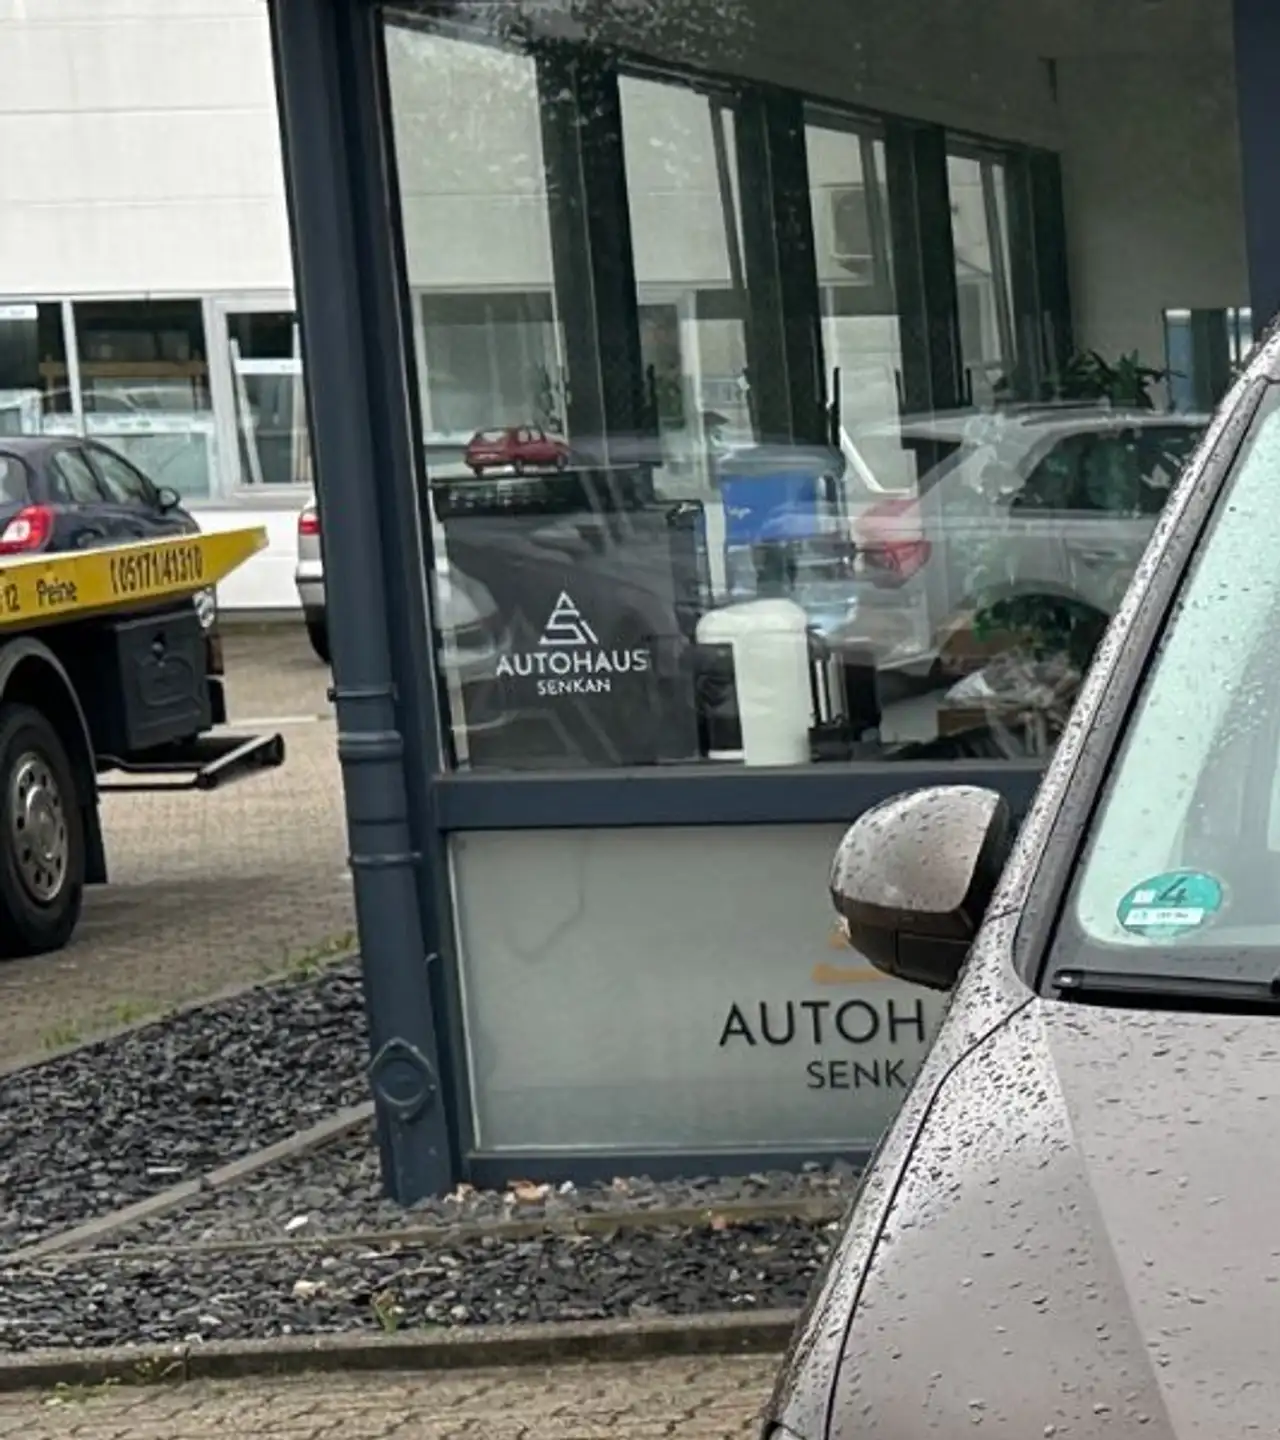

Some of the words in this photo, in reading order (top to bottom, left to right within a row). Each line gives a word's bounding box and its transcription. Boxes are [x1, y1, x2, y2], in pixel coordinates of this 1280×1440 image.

[496, 649, 650, 676] AUTOHAUS
[537, 677, 611, 696] SENKAN
[1157, 876, 1189, 907] 4
[719, 999, 926, 1046] AUTOH
[806, 1059, 907, 1089] SENK
